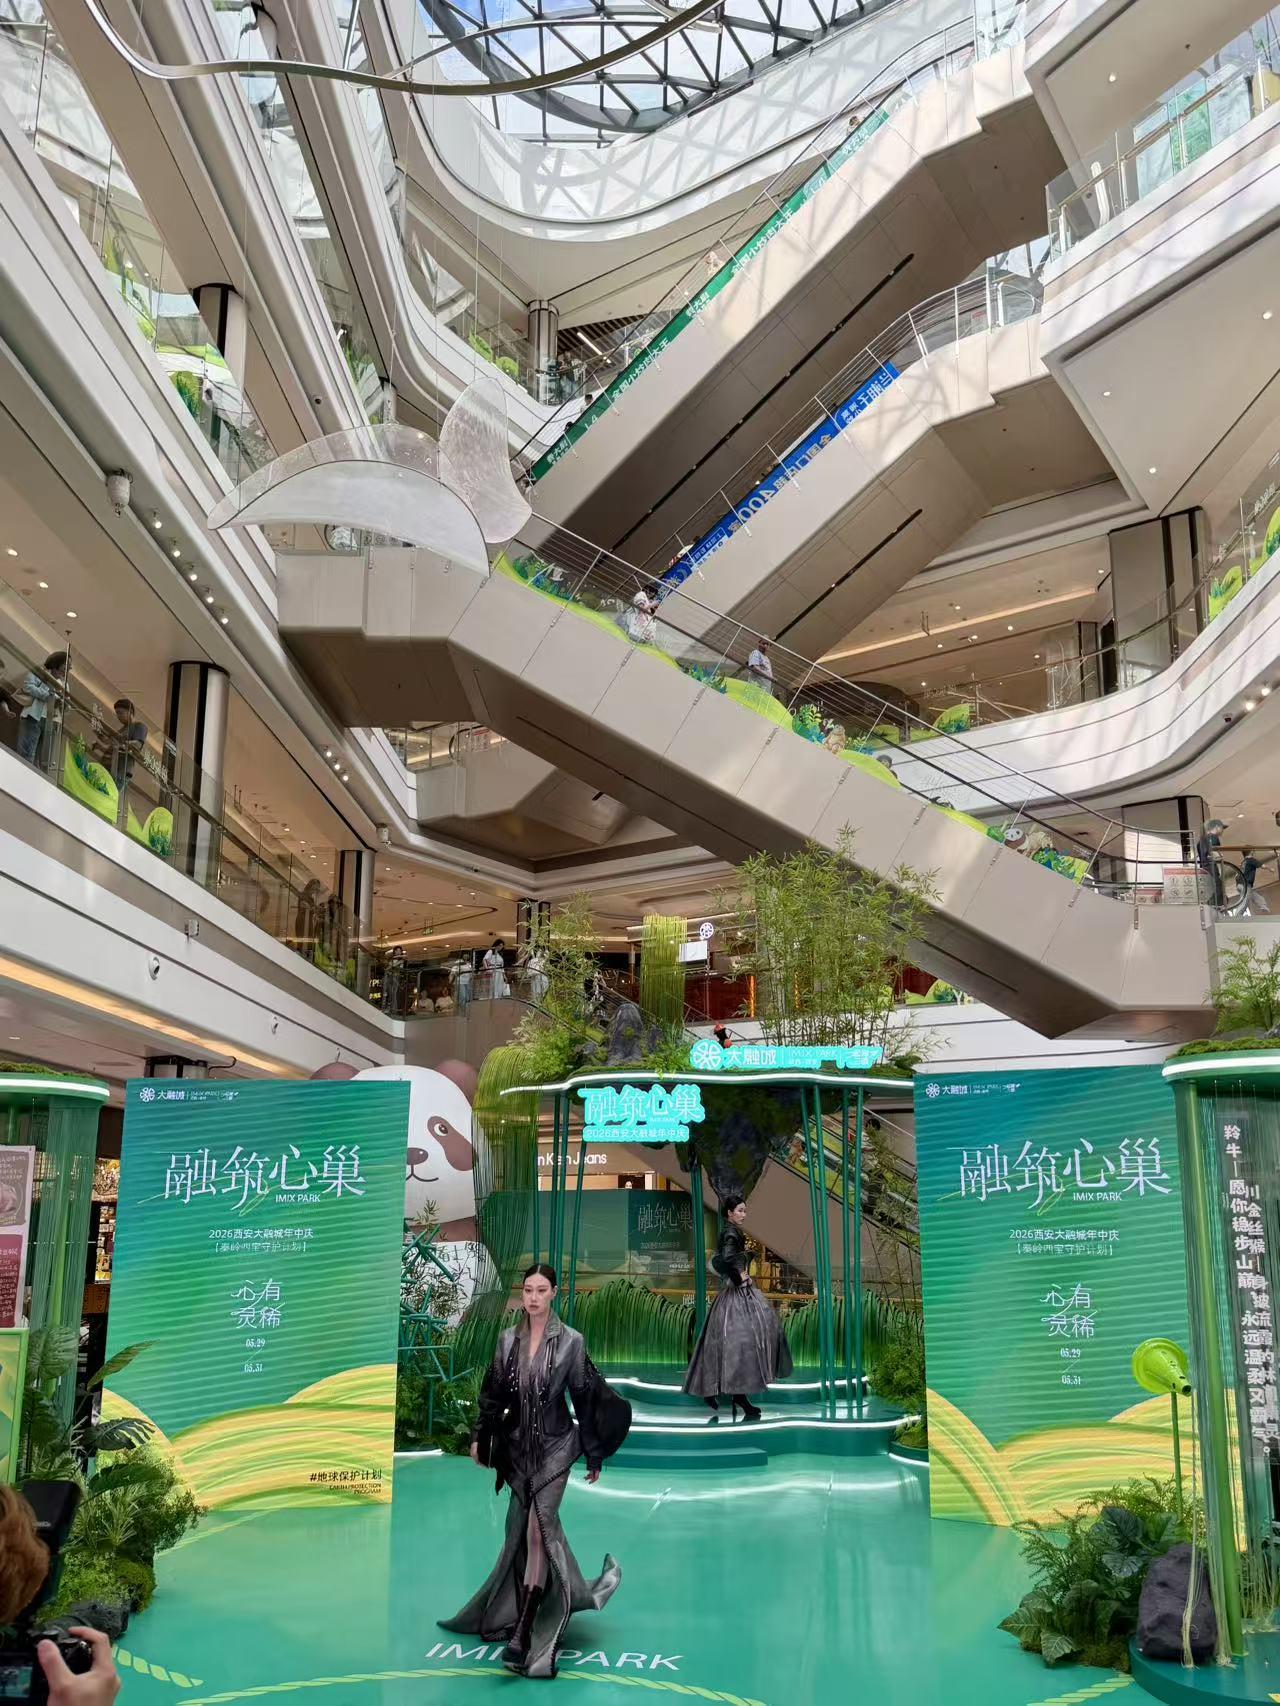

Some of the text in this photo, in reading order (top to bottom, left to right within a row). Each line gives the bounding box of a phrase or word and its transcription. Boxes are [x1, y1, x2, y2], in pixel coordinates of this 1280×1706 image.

[726, 1048, 777, 1066] 大融城
[942, 1084, 968, 1095] 大融城
[583, 1088, 703, 1127] 融筑心巢
[152, 1143, 366, 1211] 融筑心巢
[946, 1137, 1173, 1210] 融筑心巢
[275, 1193, 321, 1203] IMIX PARK
[1073, 1191, 1122, 1201] IMIX PARK
[638, 1200, 693, 1238] 融筑心巢
[208, 1228, 314, 1240] 2026西安大融城年中庆
[1009, 1229, 1120, 1241] 2026西安大融城年中庆
[231, 1278, 283, 1302] 心有
[1040, 1281, 1092, 1309] 心有
[245, 1338, 266, 1348] 05.29
[1060, 1347, 1081, 1358] 05.29
[244, 1363, 263, 1373] 05.31
[1061, 1375, 1081, 1385] 05.31
[309, 1468, 382, 1483] #地球保护计划
[425, 1642, 685, 1671] IMI PARK
